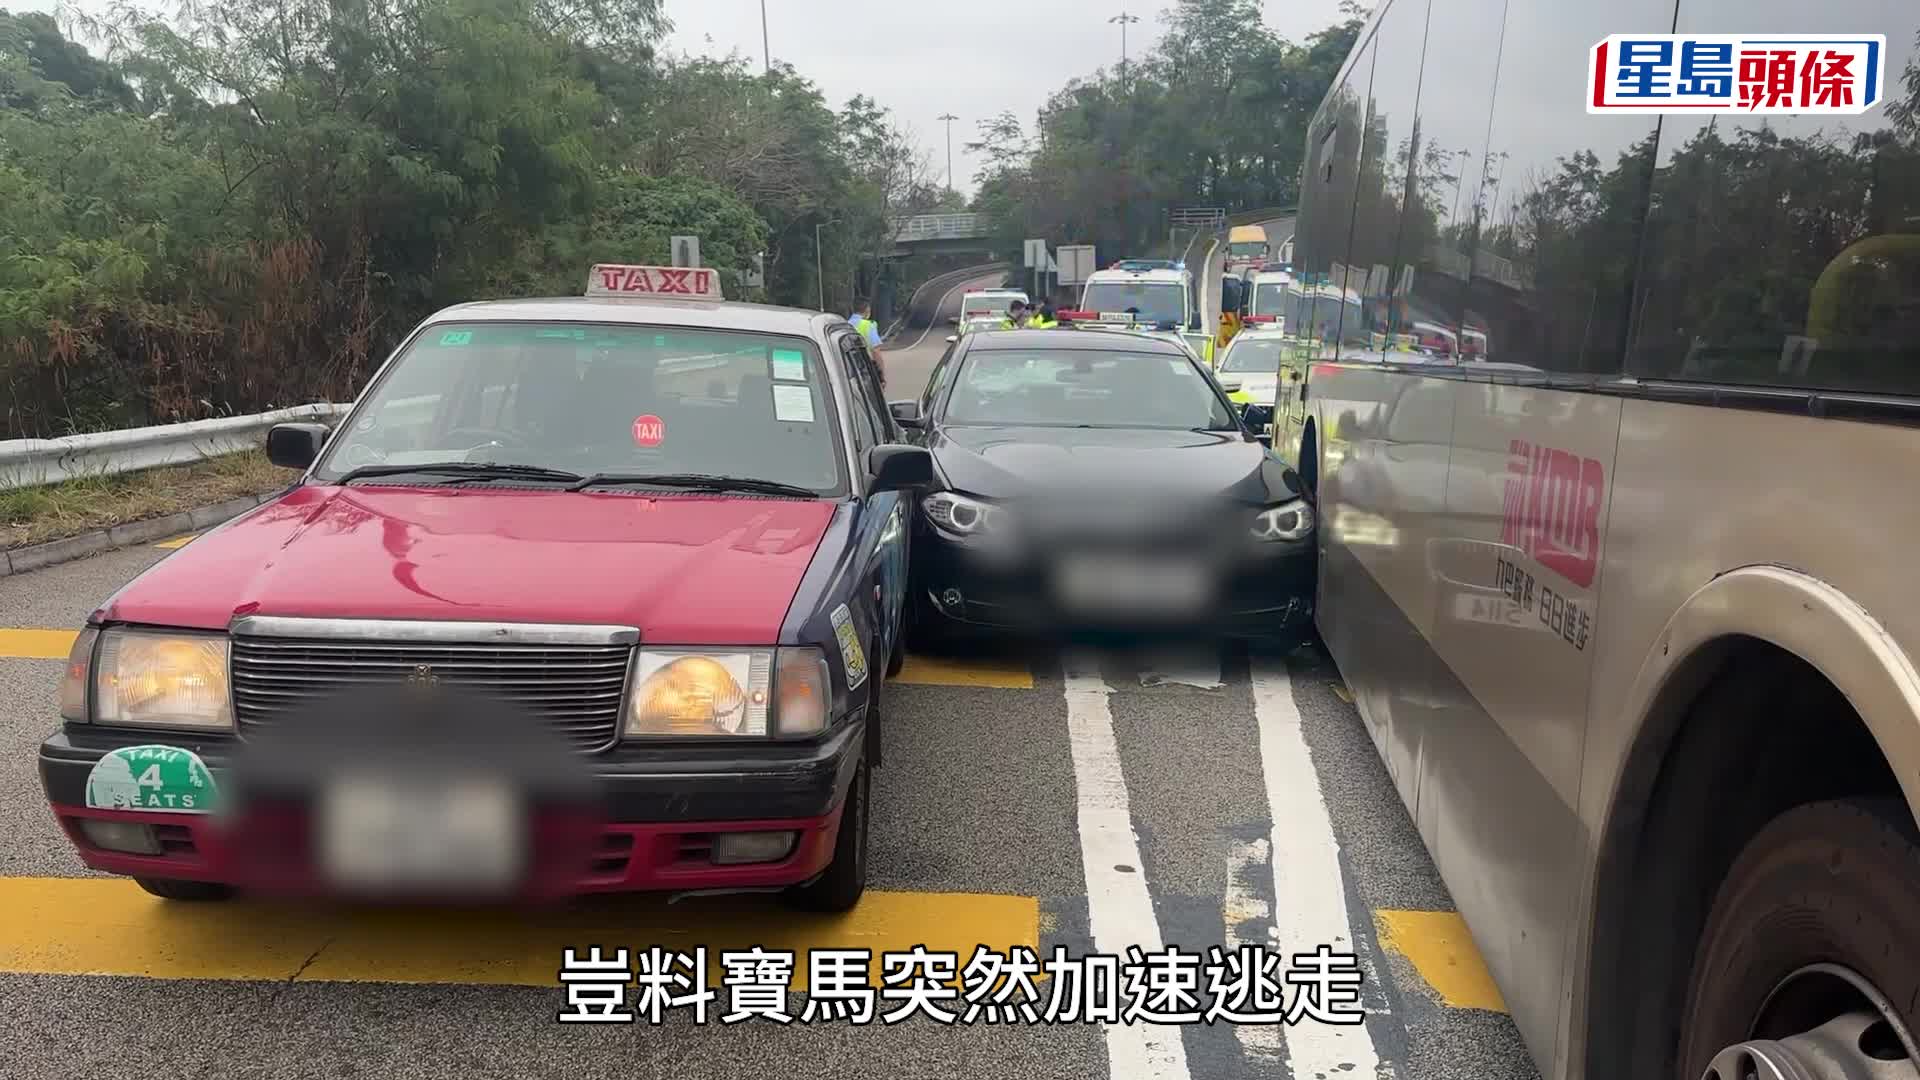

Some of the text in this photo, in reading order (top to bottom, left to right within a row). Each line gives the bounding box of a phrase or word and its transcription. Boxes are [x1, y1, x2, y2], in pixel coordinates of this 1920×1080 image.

[599, 267, 709, 294] TAXI
[635, 423, 662, 440] TAXI
[128, 750, 179, 763] TAXI
[138, 764, 163, 791] 4
[113, 793, 195, 808] SEATS
